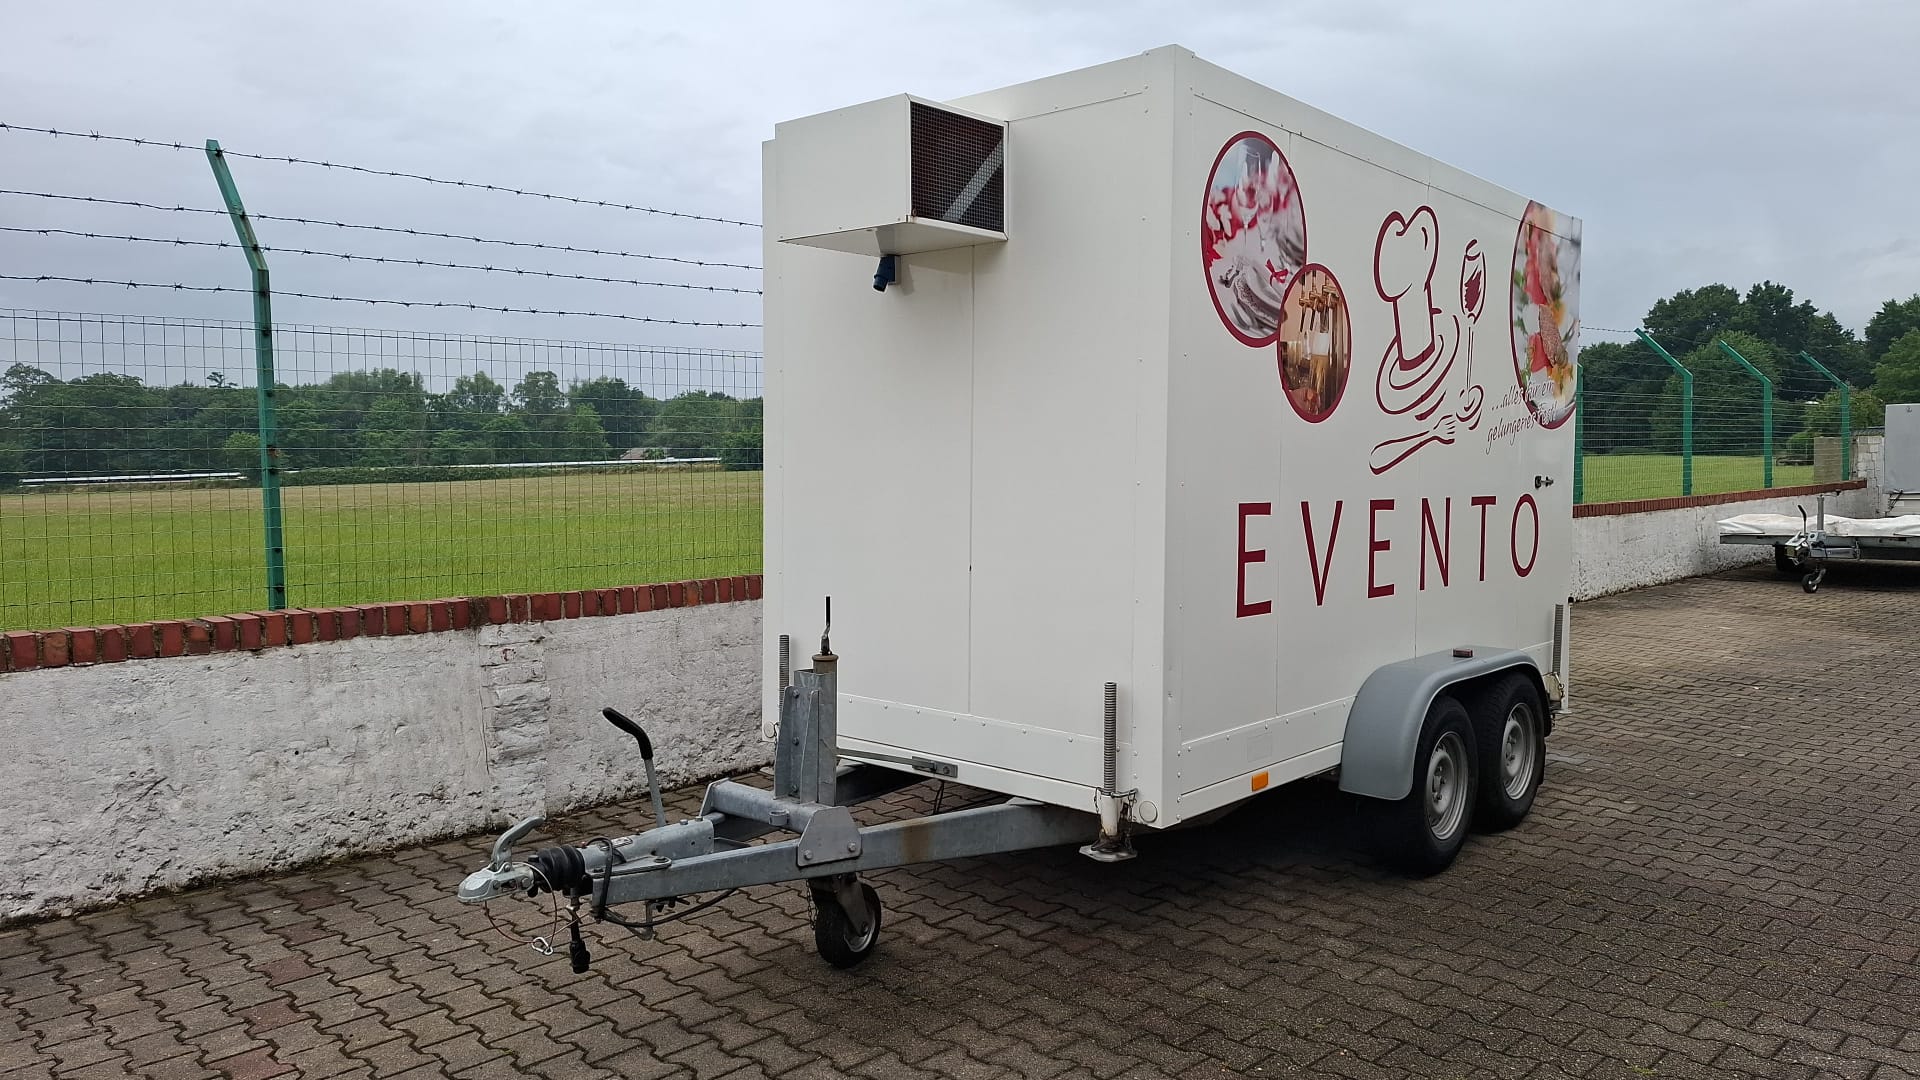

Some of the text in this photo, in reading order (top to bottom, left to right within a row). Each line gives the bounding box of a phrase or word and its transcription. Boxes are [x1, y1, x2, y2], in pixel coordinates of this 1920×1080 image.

[1525, 381, 1541, 402] für
[1541, 381, 1554, 396] ein
[1485, 412, 1536, 455] gelungenes
[1236, 493, 1539, 618] EVENTO
